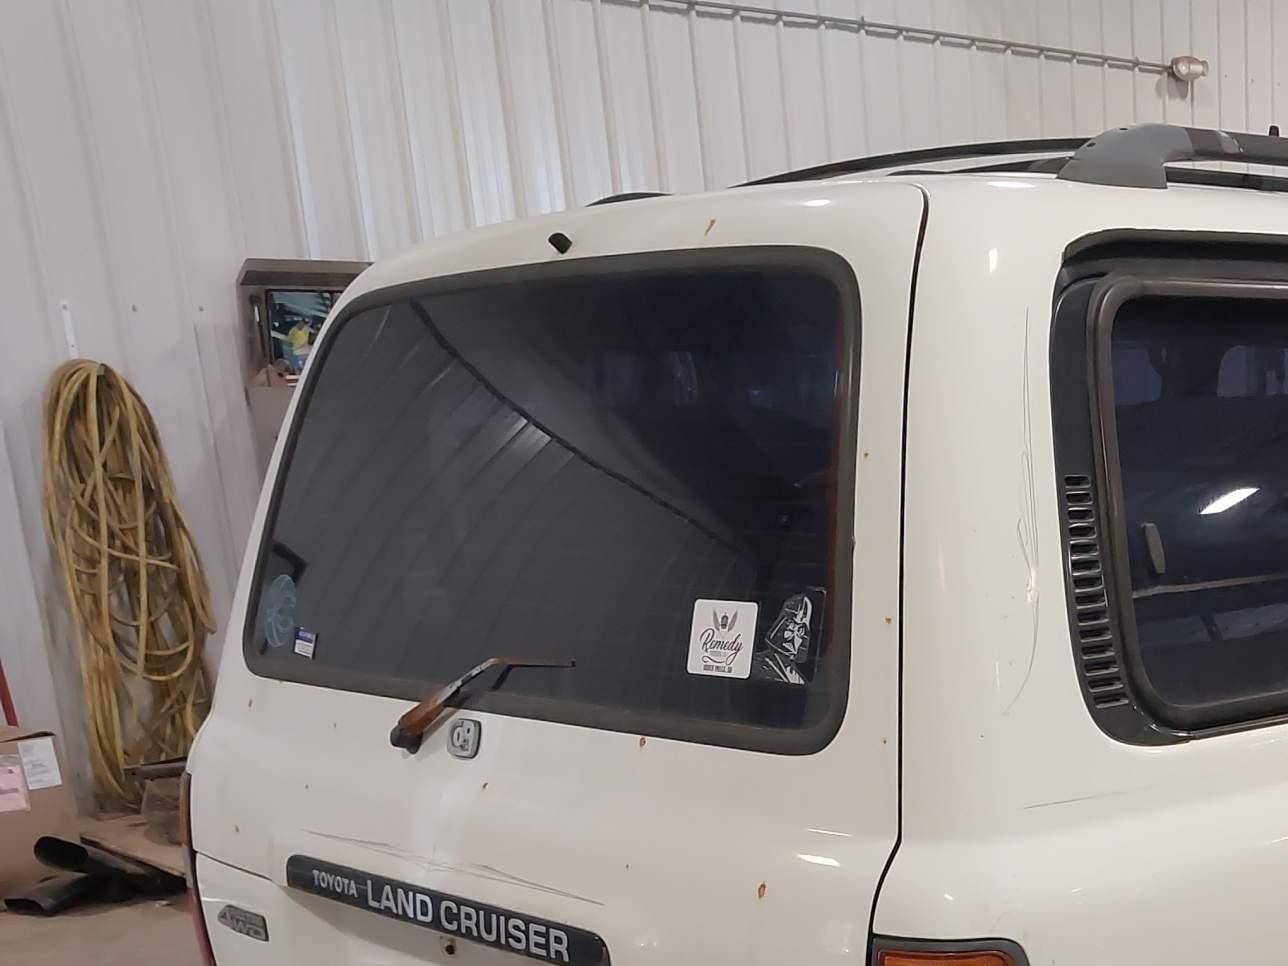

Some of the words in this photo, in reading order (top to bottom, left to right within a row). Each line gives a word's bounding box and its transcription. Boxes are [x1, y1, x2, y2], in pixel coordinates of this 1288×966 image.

[700, 628, 744, 666] Remedy
[312, 869, 358, 898] TOYOTA
[366, 879, 434, 923] LAND
[439, 899, 571, 963] CRUISER
